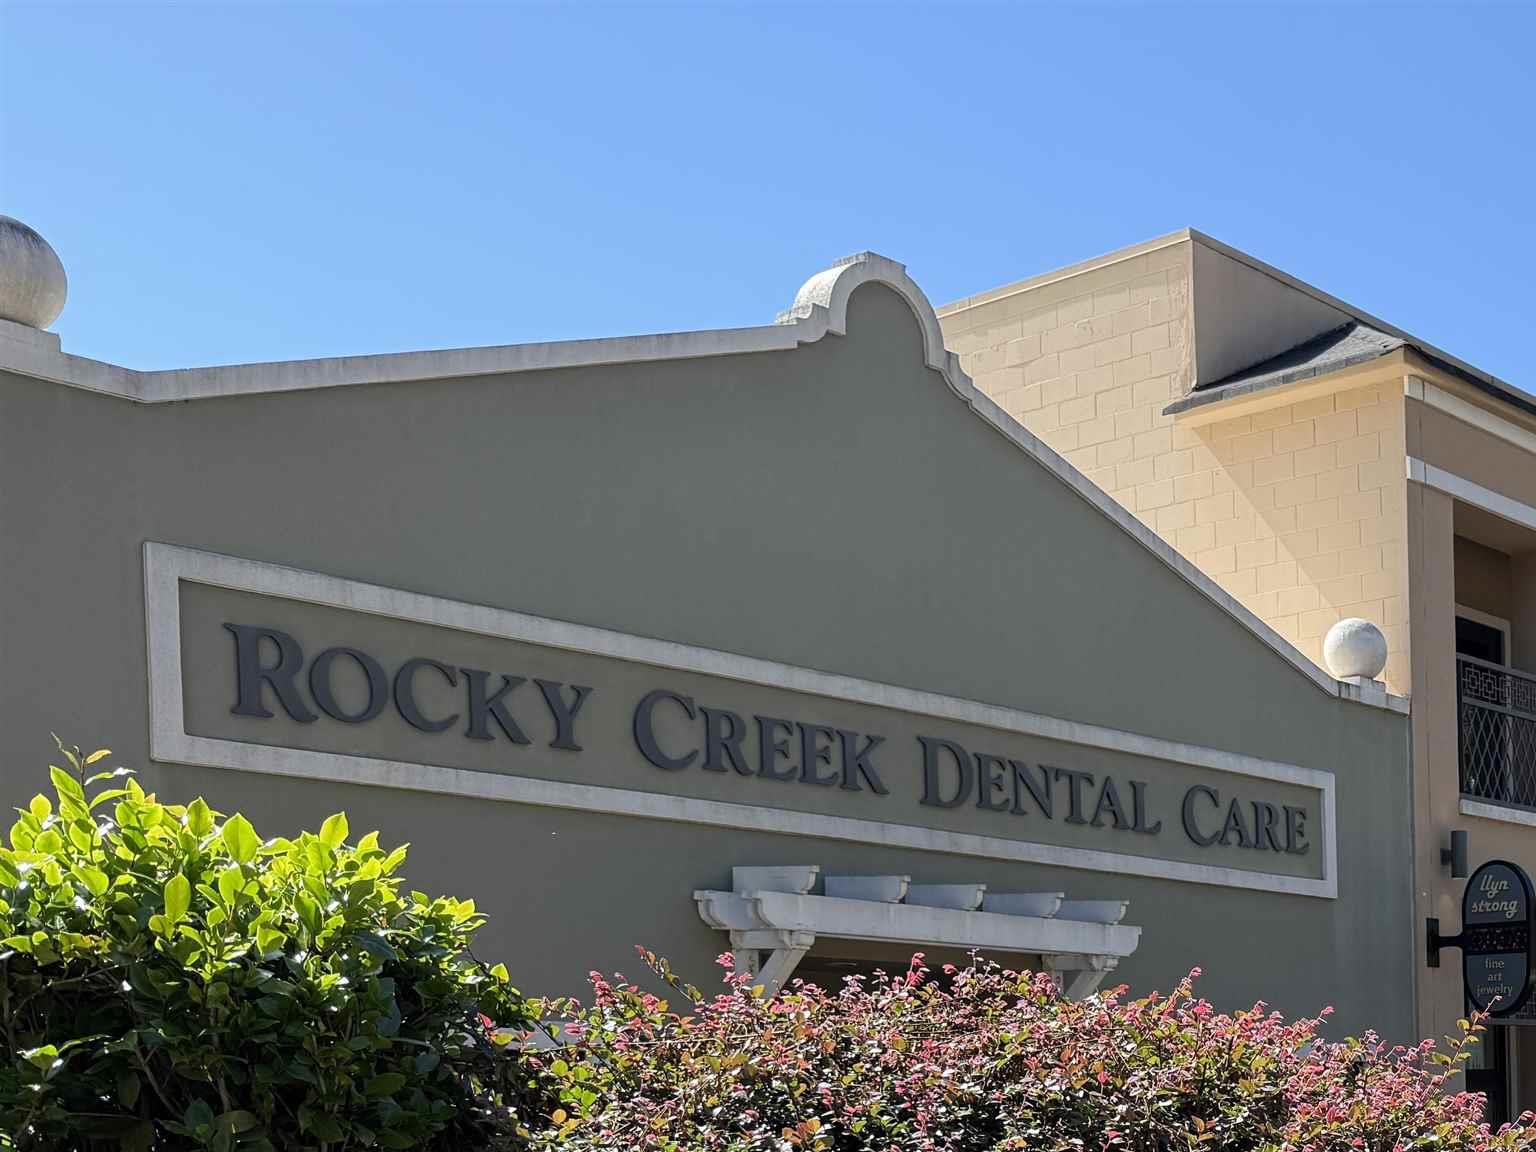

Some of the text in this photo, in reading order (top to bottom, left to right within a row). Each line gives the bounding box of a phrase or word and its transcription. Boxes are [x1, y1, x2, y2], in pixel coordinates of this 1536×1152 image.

[224, 622, 1310, 856] ROCKY CREEK DENTAL CARE
[1480, 874, 1509, 898] llyn
[1472, 900, 1518, 918] strong
[1485, 958, 1505, 969] fine
[1487, 973, 1503, 981] art
[1476, 983, 1513, 997] jewelry
